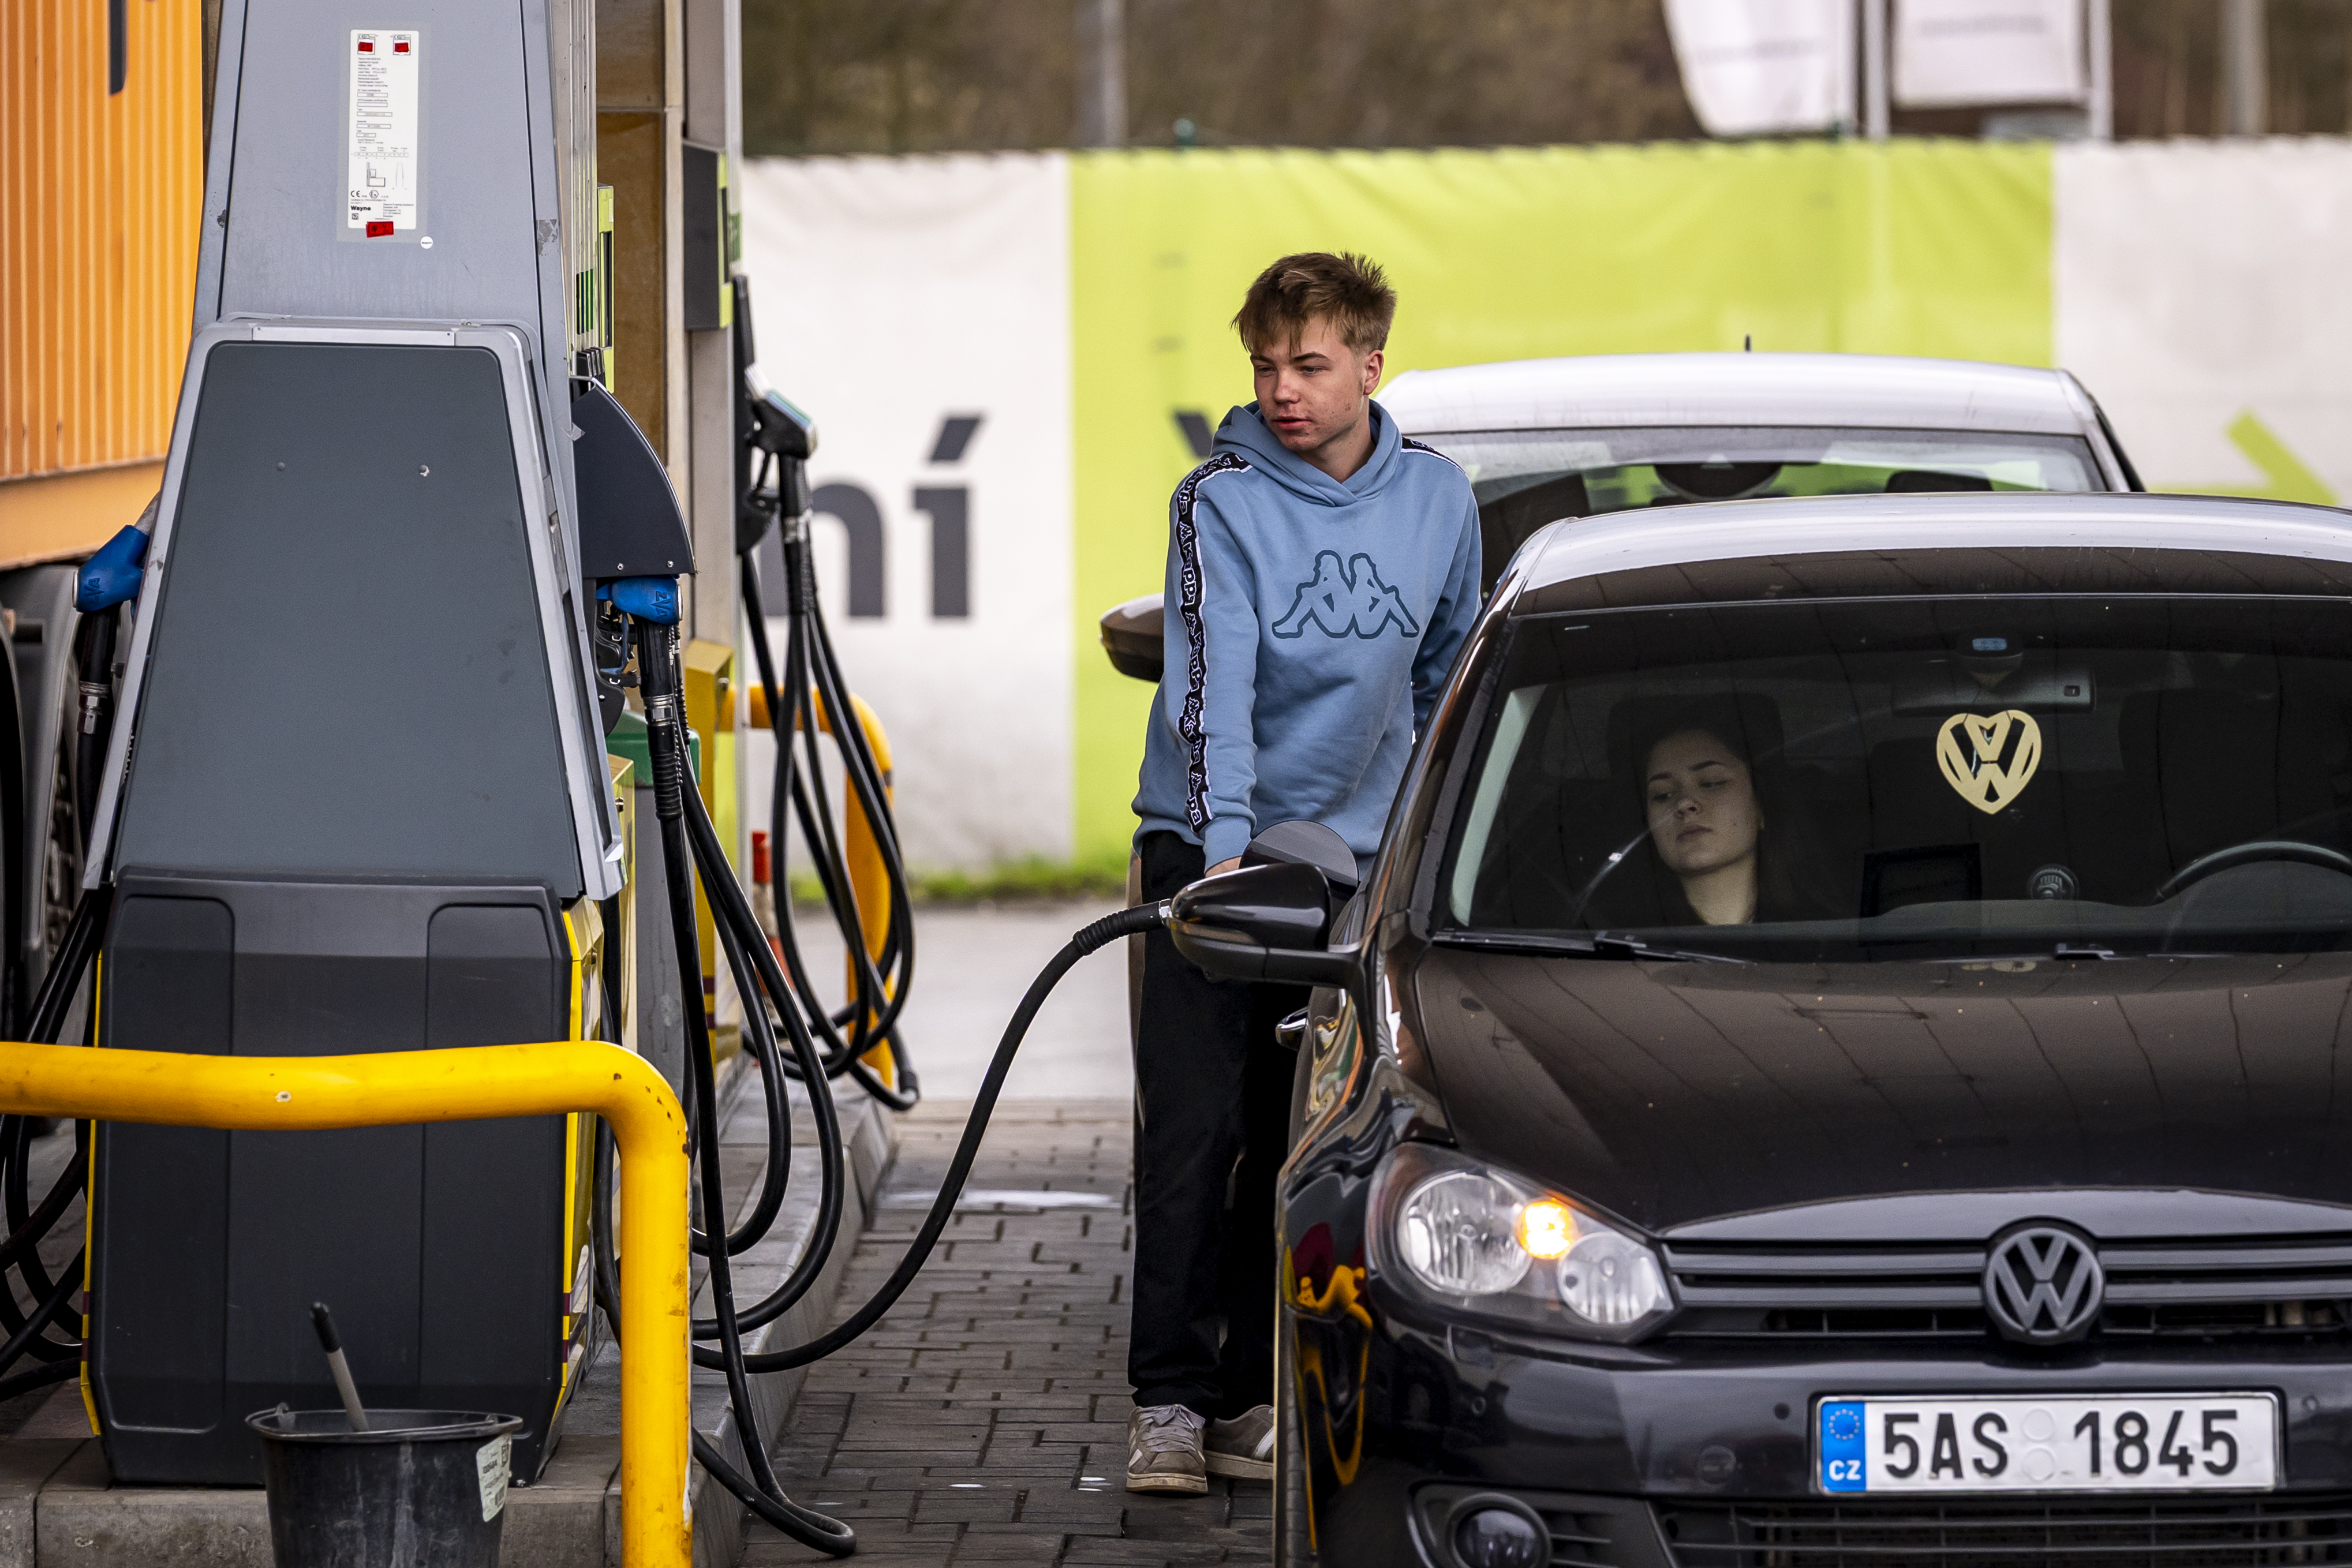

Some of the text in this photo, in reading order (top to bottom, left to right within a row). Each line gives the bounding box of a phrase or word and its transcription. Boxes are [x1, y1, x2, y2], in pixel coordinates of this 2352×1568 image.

[650, 590, 671, 617] ZVA
[1828, 1410, 2237, 1481] CZ 5AS 1845
